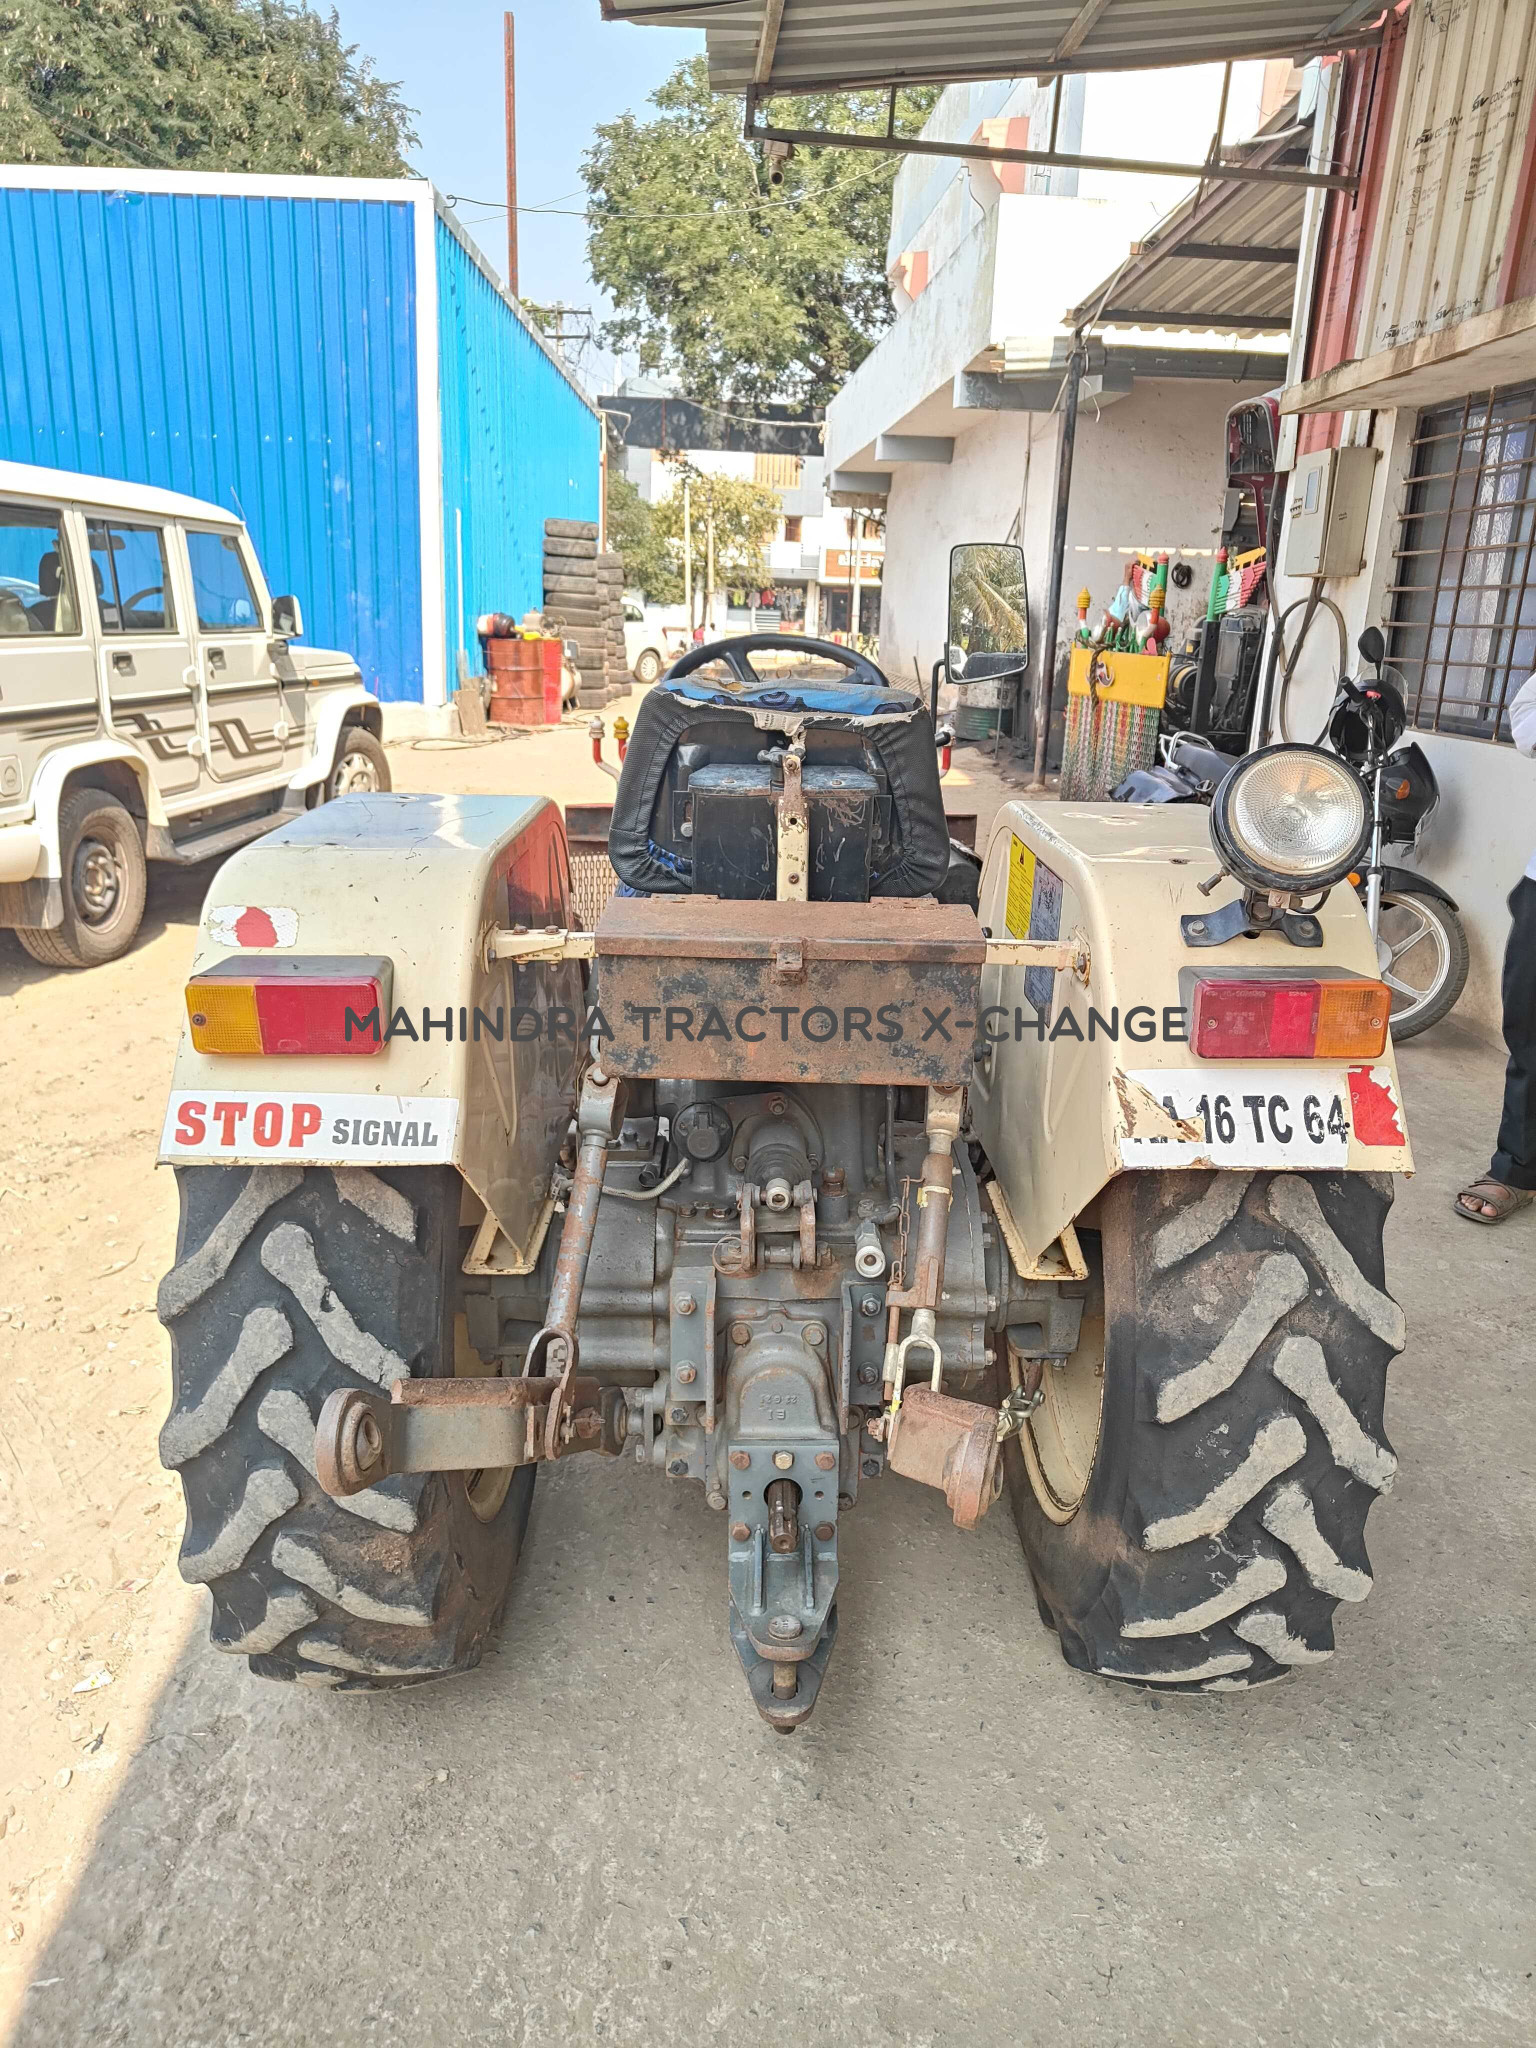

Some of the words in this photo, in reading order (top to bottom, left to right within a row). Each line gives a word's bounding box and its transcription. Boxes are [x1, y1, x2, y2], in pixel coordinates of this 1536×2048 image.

[174, 1100, 323, 1148] STOP
[332, 1118, 438, 1147] SIGNAL
[1196, 1094, 1236, 1144] 16
[1242, 1094, 1293, 1144] TC
